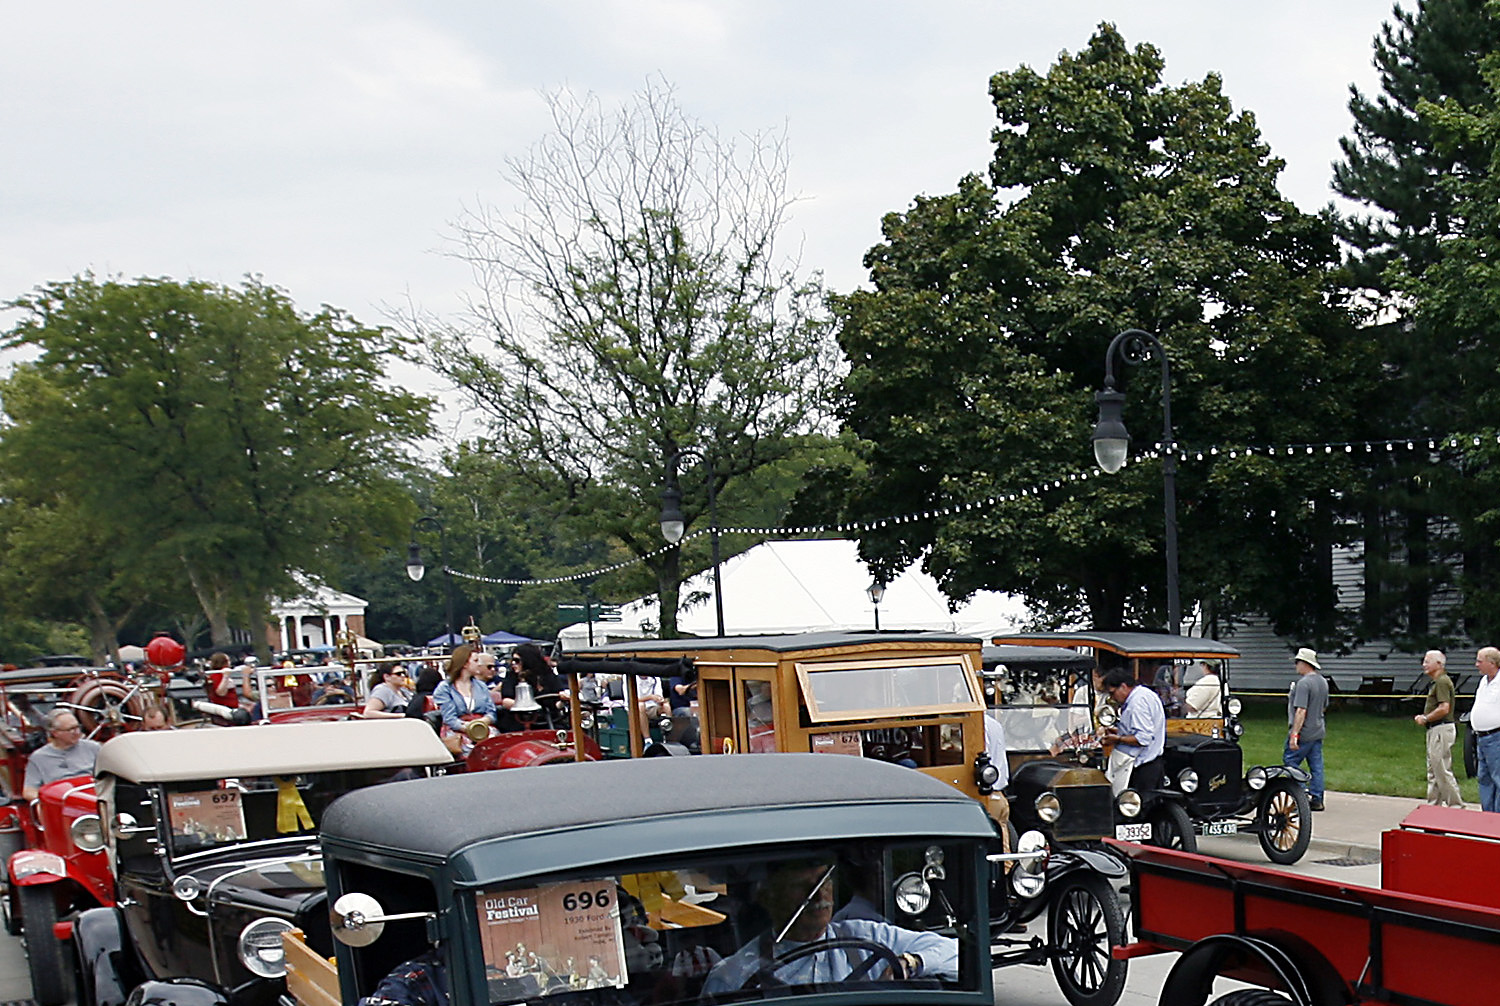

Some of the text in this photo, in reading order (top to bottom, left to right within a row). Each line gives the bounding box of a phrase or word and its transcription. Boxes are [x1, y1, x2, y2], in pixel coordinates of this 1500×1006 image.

[1208, 773, 1227, 792] Ford
[212, 792, 237, 804] 697
[485, 896, 529, 910] Old Car
[562, 888, 610, 912] 696
[486, 904, 540, 921] Festival
[564, 915, 584, 925] 1930
